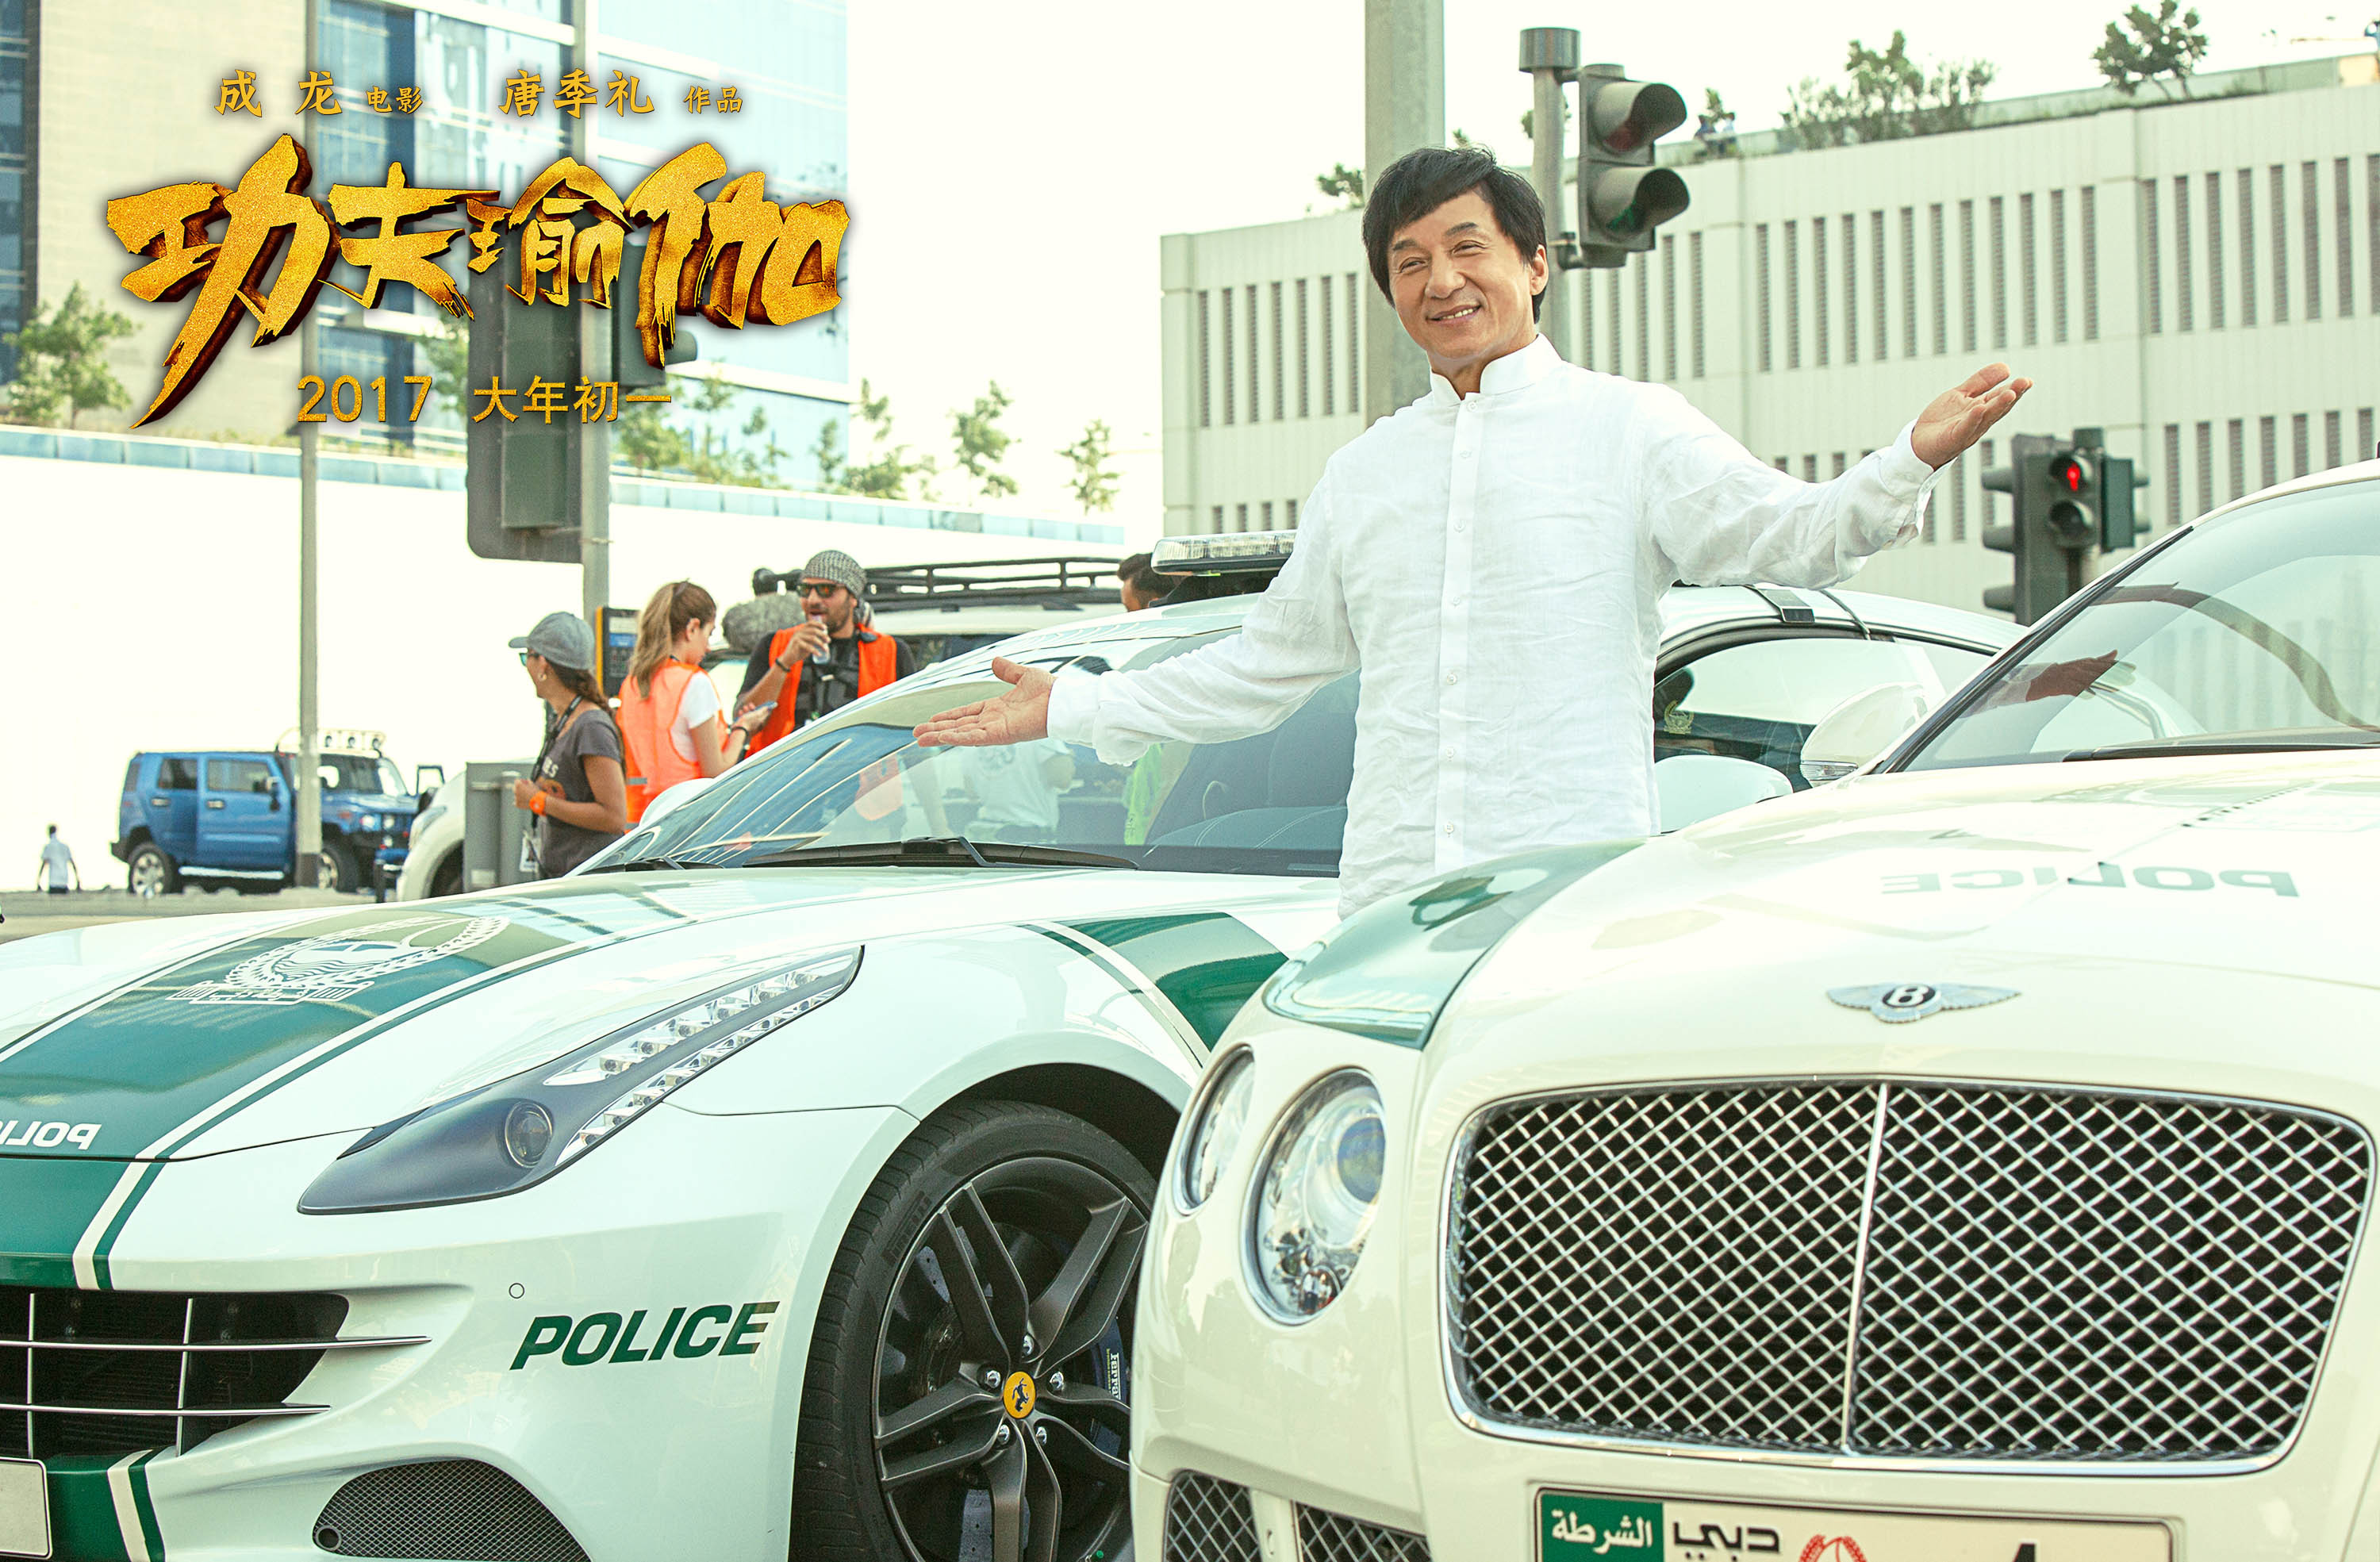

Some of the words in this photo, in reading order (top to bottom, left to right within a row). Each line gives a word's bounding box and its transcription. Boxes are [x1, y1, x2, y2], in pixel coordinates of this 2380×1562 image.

[509, 1301, 780, 1370] POLICE
[1111, 1353, 1121, 1399] Ferra
[1551, 1509, 1653, 1553] الشرطة
[1672, 1521, 1780, 1562] دبي
